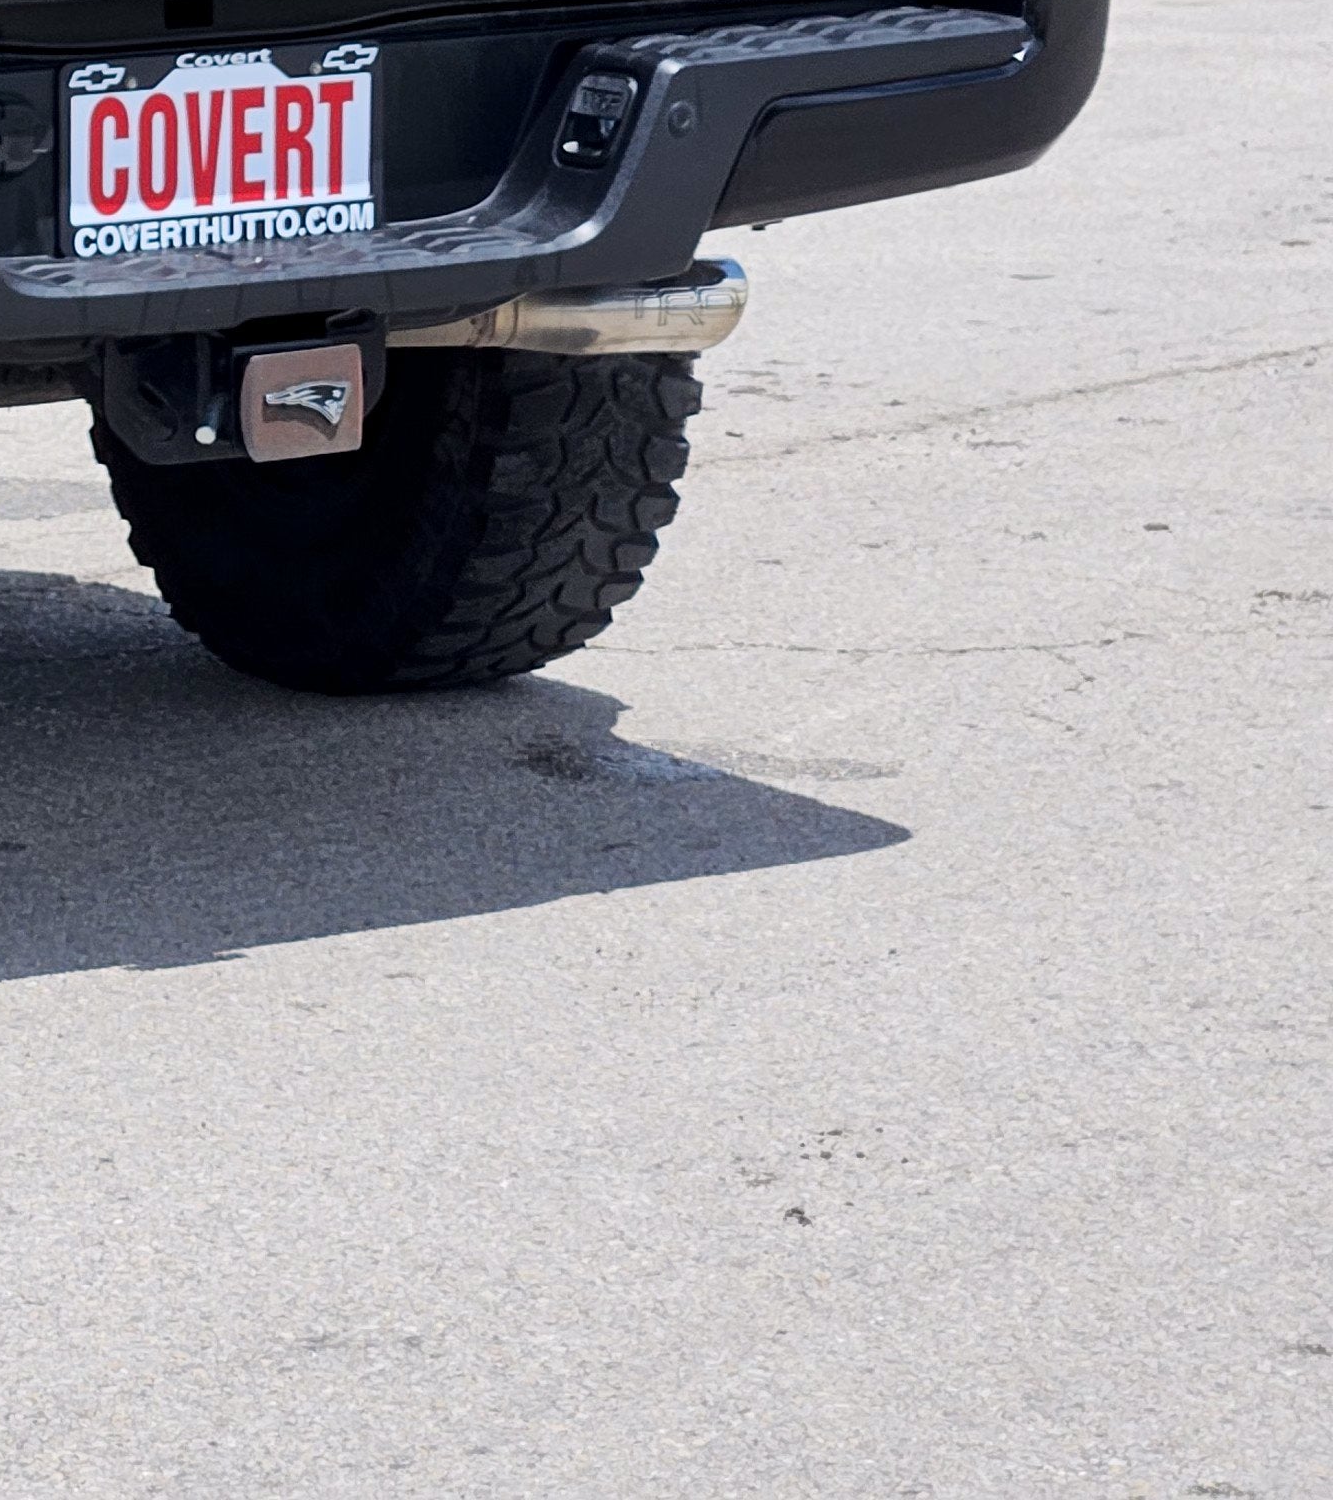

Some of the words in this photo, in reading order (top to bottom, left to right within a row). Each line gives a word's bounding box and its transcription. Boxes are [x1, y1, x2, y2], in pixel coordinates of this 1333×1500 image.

[175, 48, 273, 68] Covert
[88, 80, 355, 216] COVERT
[73, 201, 375, 258] COVERTHUTTO.COM
[623, 286, 742, 327] TRD
